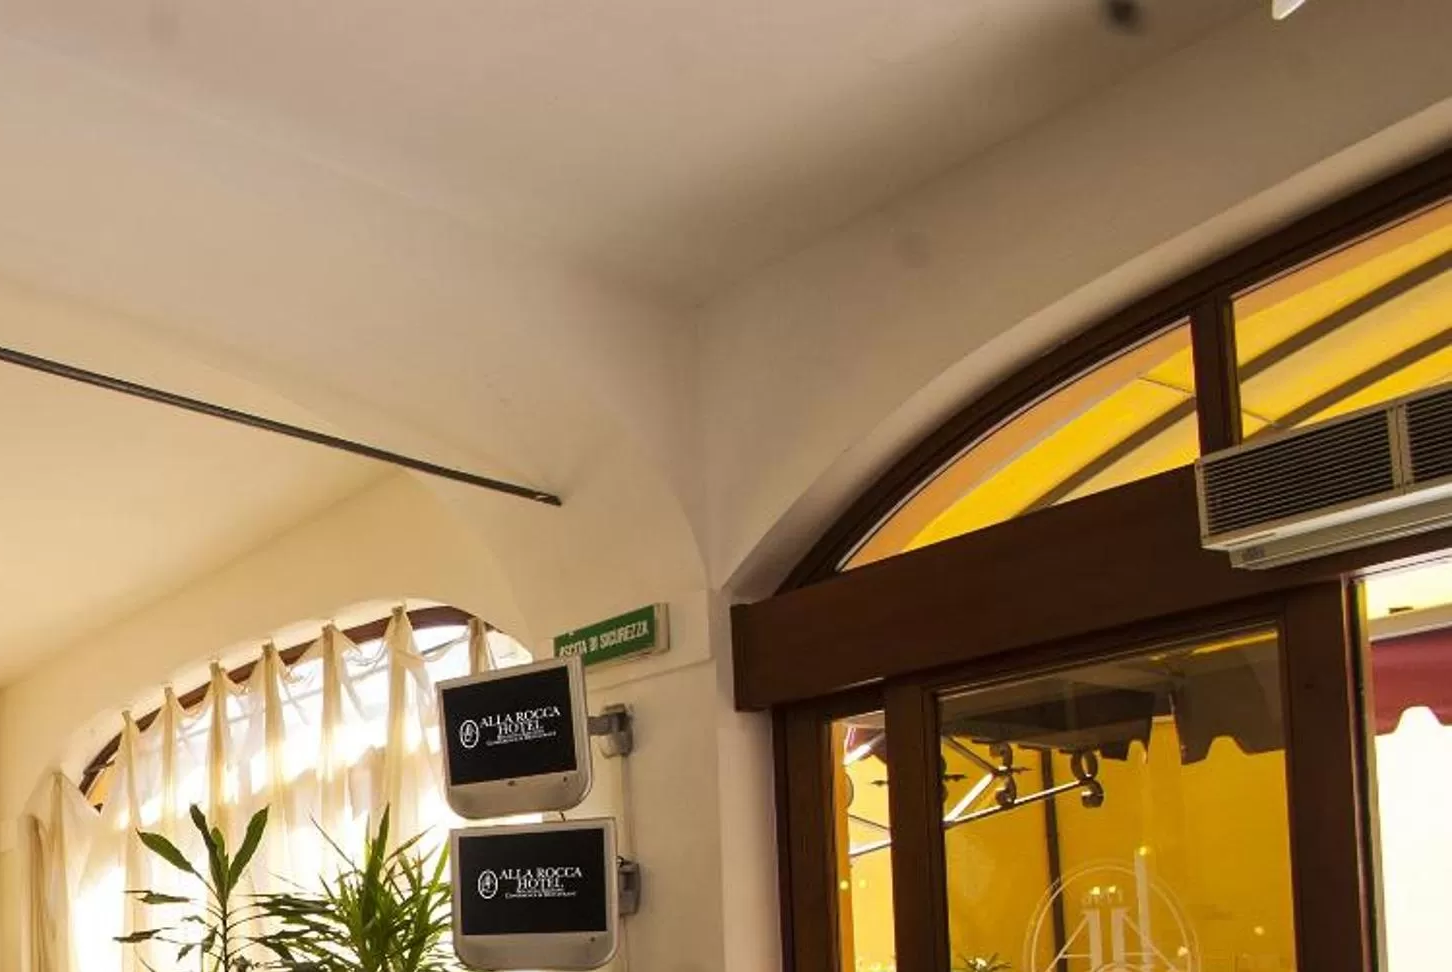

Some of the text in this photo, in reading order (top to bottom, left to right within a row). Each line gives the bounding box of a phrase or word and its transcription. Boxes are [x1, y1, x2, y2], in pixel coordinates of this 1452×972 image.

[599, 620, 649, 649] SICUREZZA
[479, 705, 561, 728] ALLA ROCCA
[497, 719, 544, 736] HOTEL
[499, 866, 582, 880] ALLA ROCCA
[517, 877, 565, 890] HOTEL
